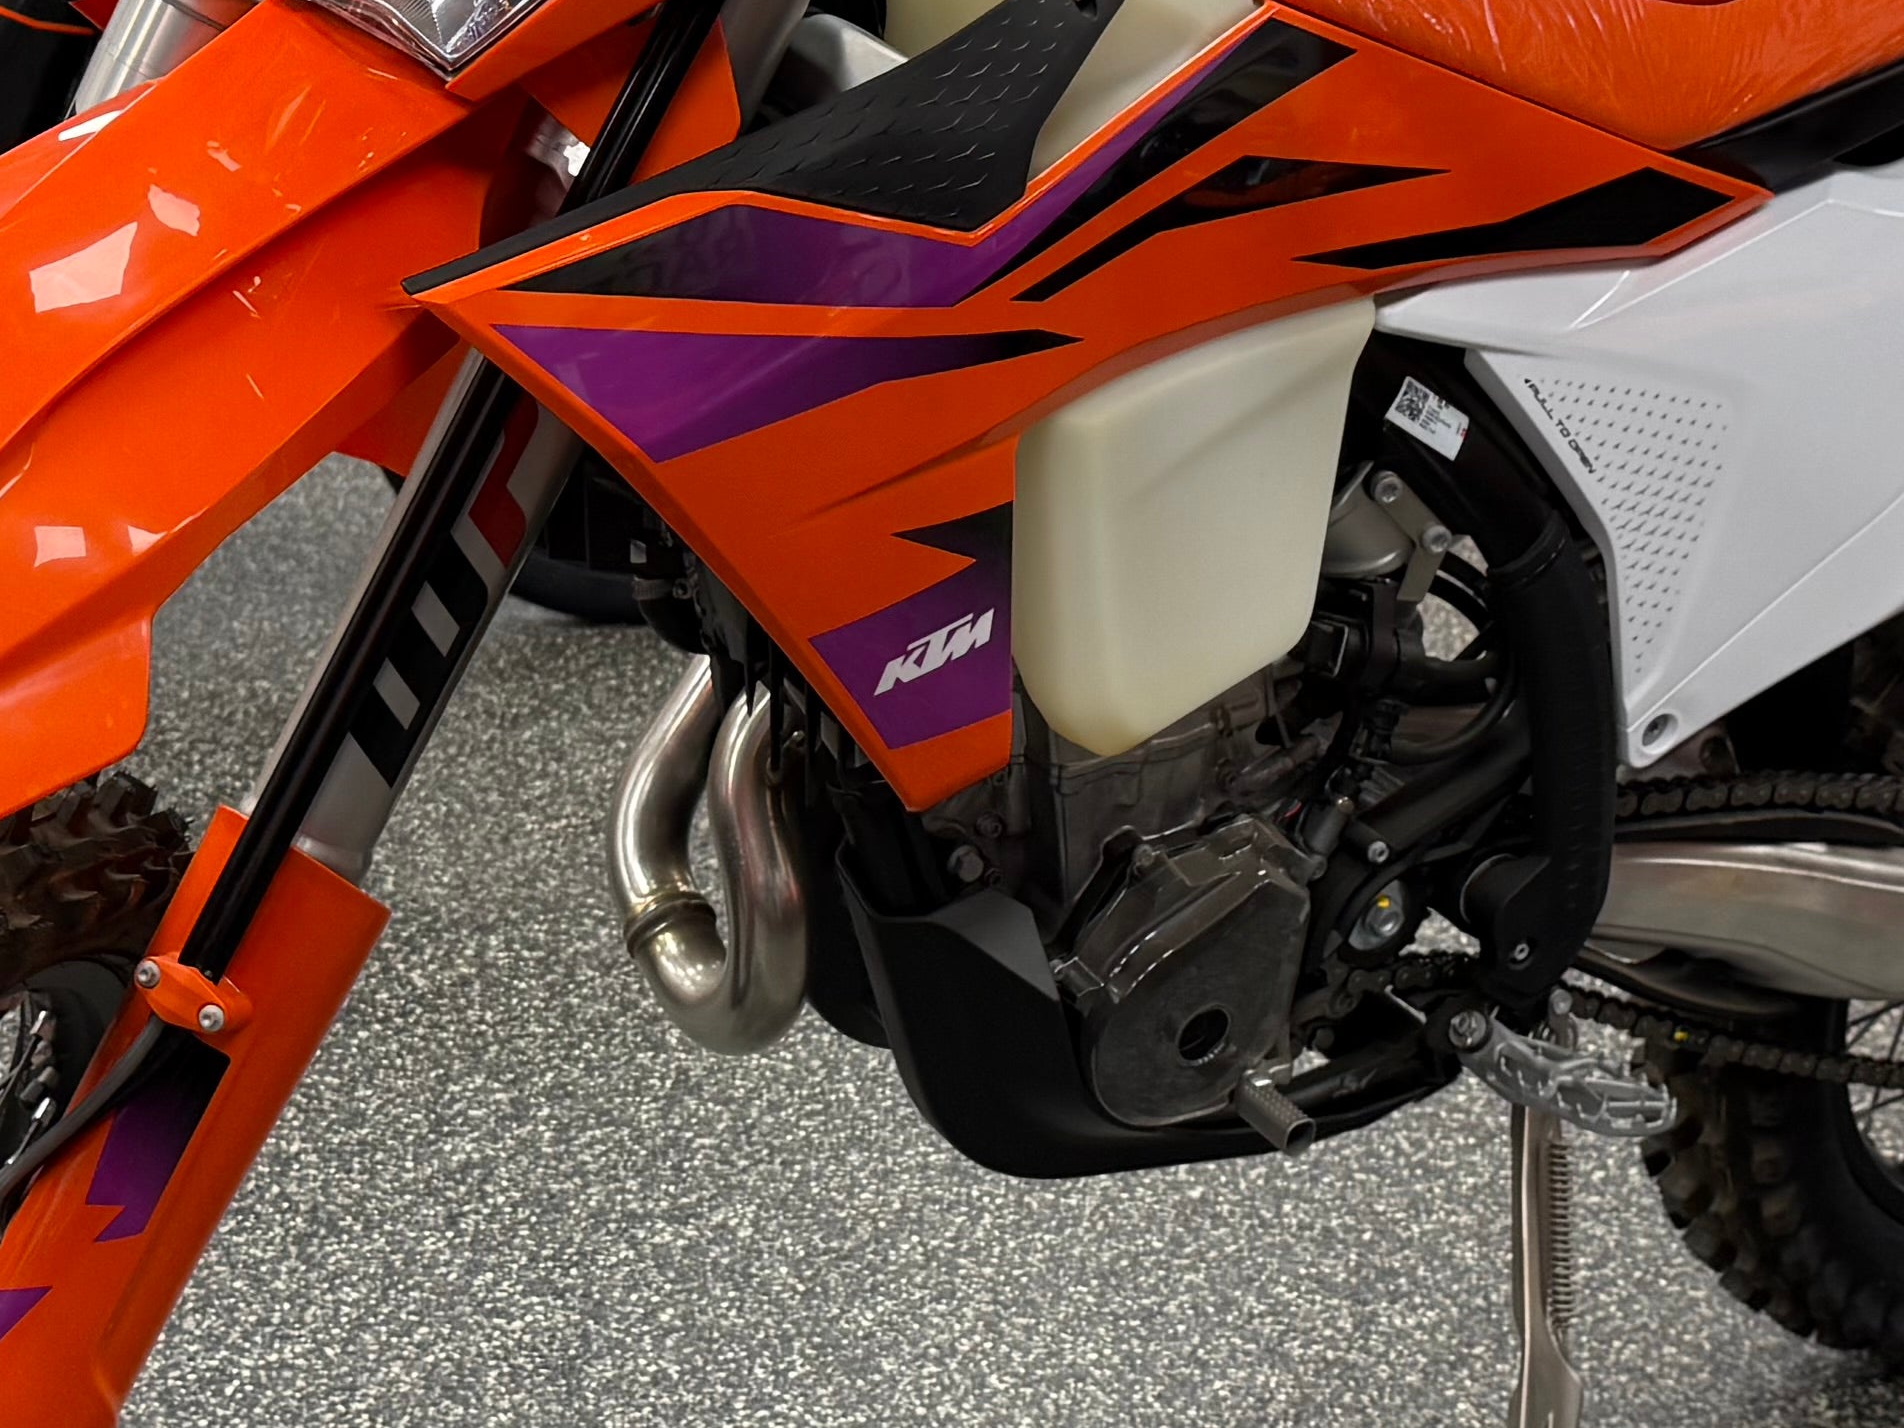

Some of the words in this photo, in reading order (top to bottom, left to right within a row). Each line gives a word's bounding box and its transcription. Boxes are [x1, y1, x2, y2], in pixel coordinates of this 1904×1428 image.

[1528, 383, 1554, 421] PULL
[1555, 419, 1572, 436] TO
[1567, 434, 1597, 475] OPEN
[873, 607, 995, 696] KTM
